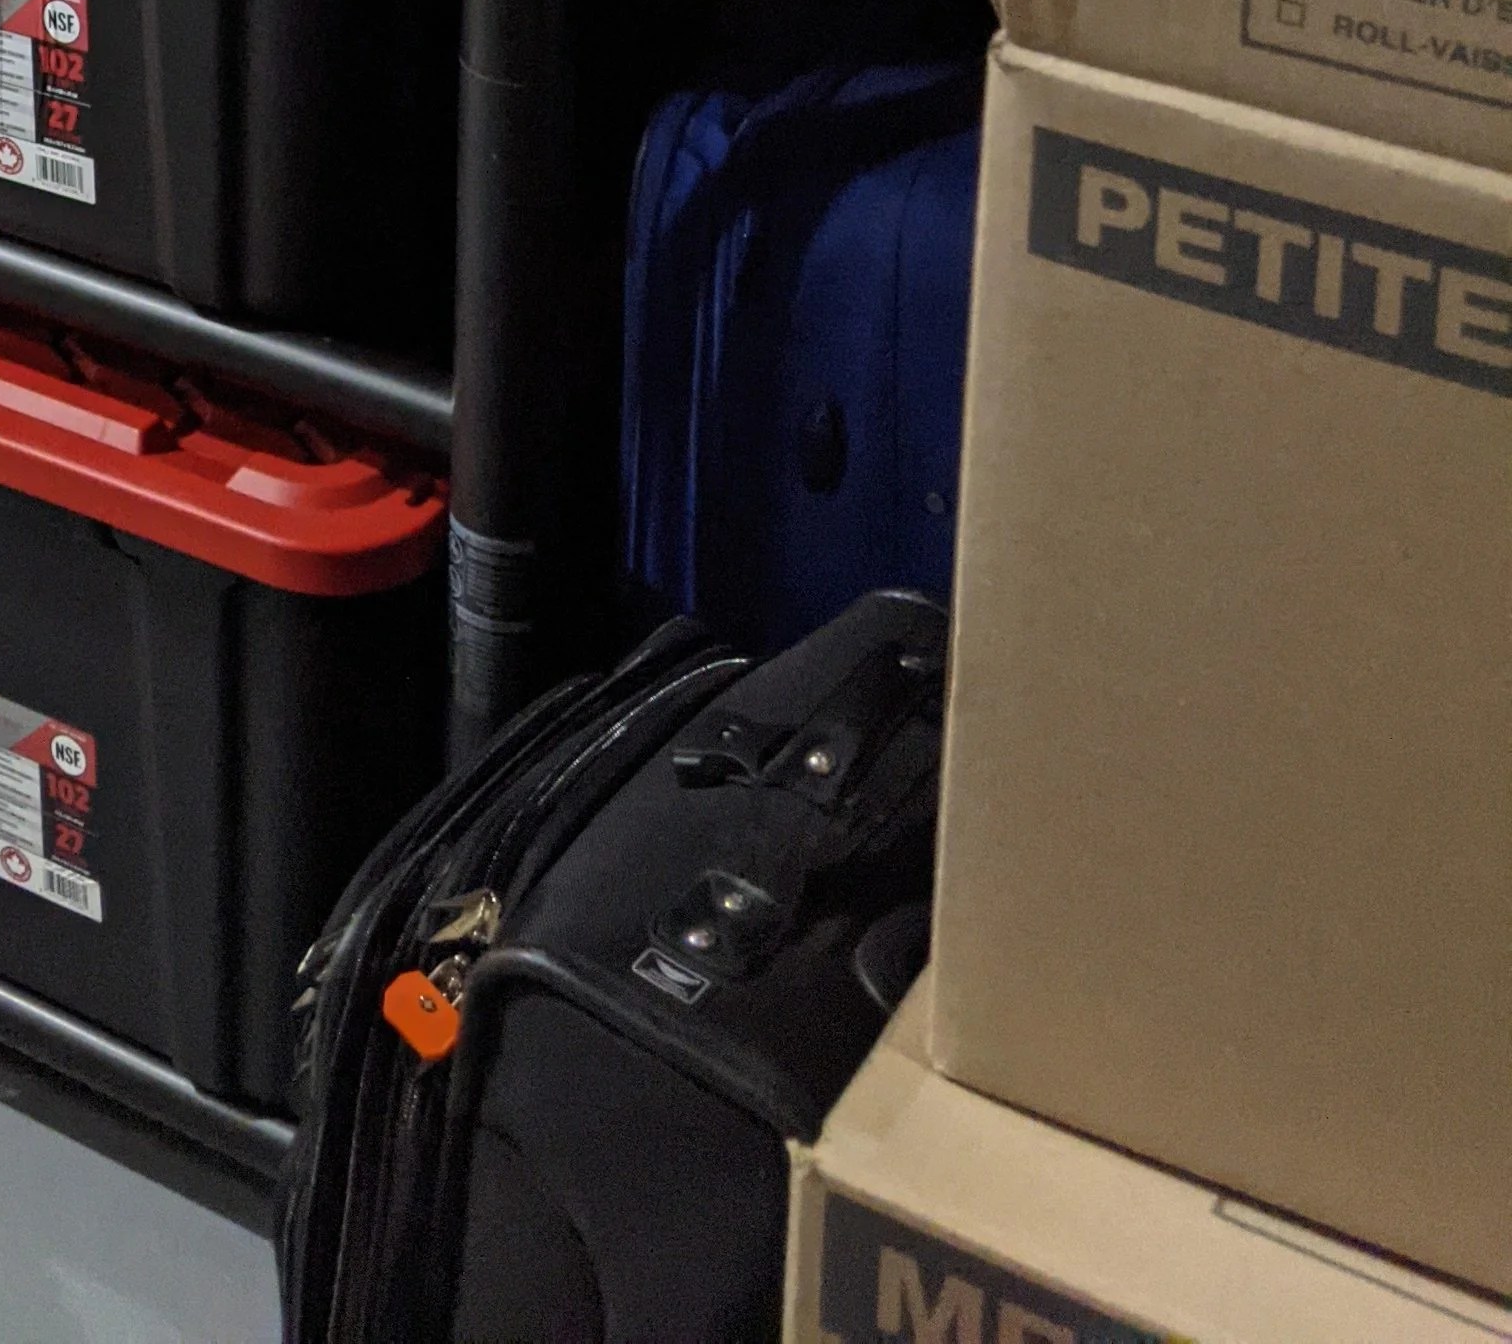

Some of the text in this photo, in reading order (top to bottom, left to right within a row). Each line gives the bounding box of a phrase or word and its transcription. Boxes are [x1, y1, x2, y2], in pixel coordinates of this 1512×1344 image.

[47, 11, 75, 34] NSF
[39, 44, 85, 83] 102
[46, 99, 80, 133] 27
[1076, 164, 1512, 369] PETITE
[55, 742, 82, 768] NSF
